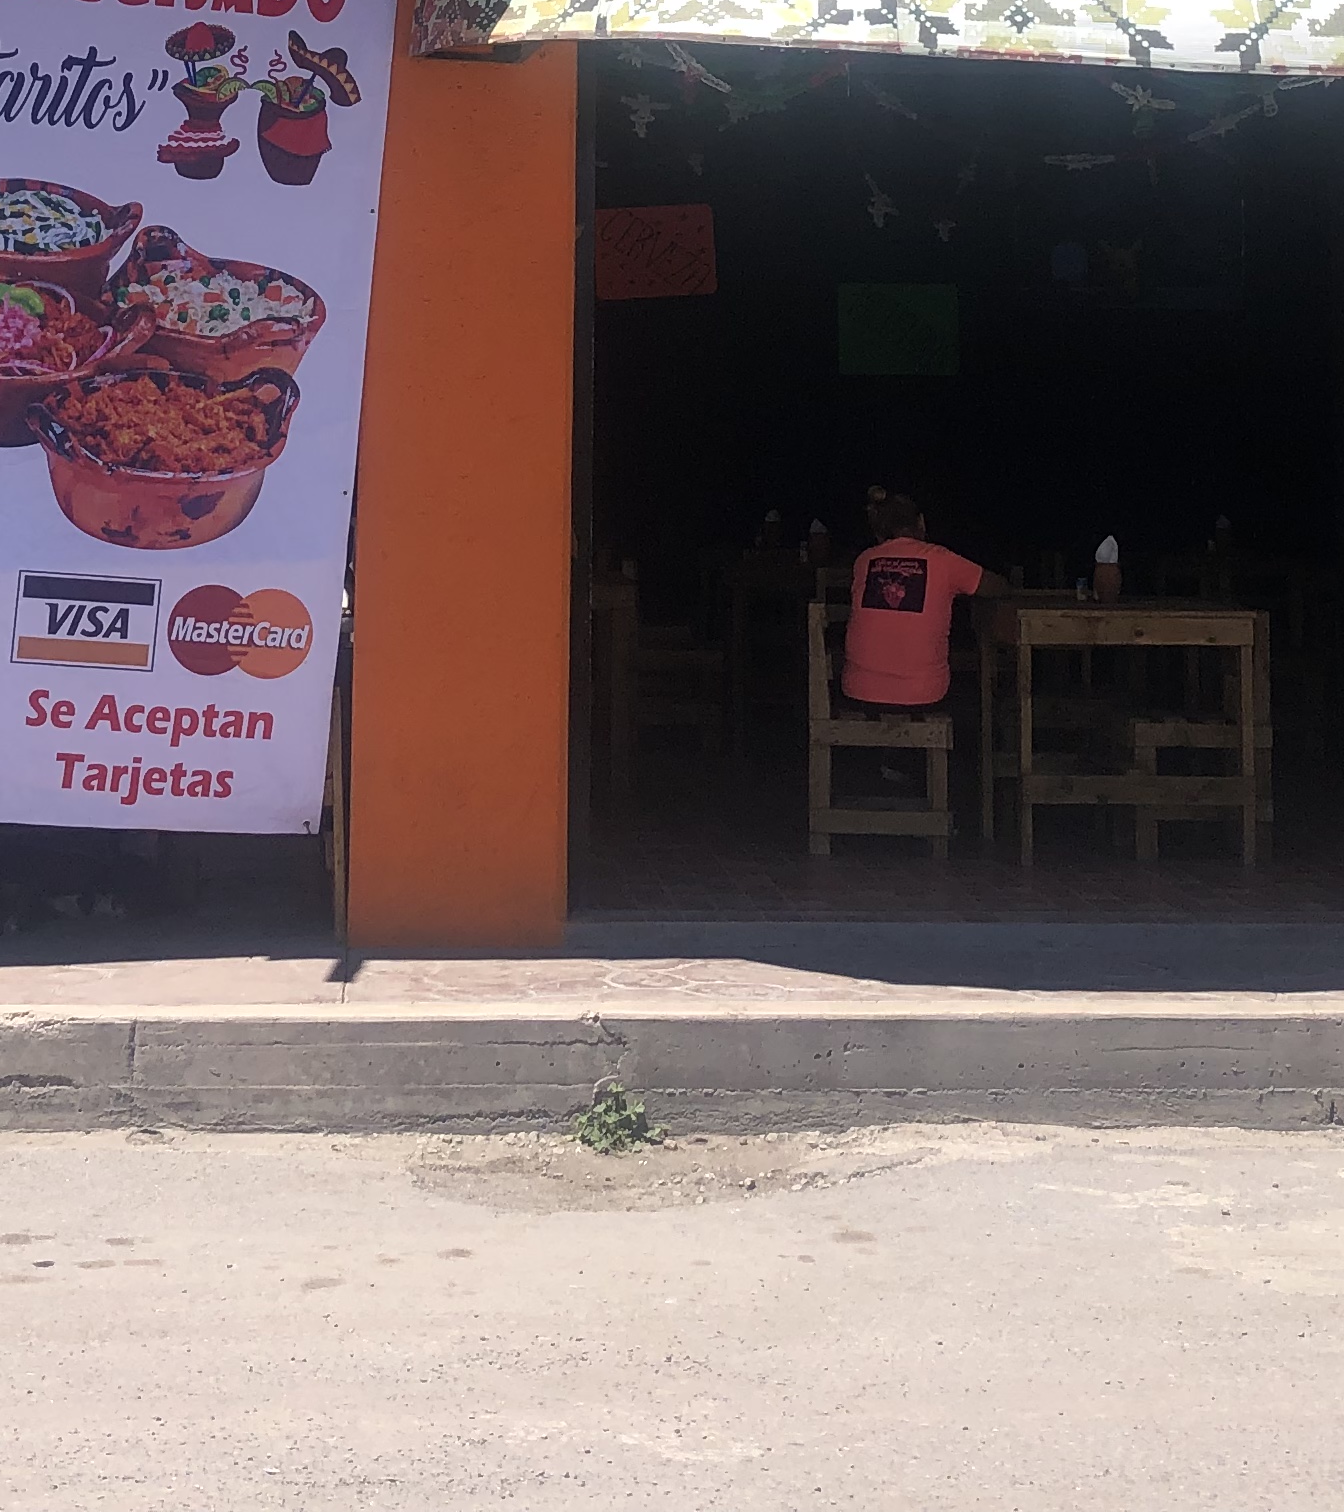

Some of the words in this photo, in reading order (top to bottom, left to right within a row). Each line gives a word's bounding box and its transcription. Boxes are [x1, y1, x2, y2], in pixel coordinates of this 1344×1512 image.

[44, 602, 130, 640] VISA
[170, 616, 310, 650] MasterCard
[25, 689, 76, 729] Se
[85, 693, 274, 748] Aceptan
[55, 752, 234, 806] Tarjetas
